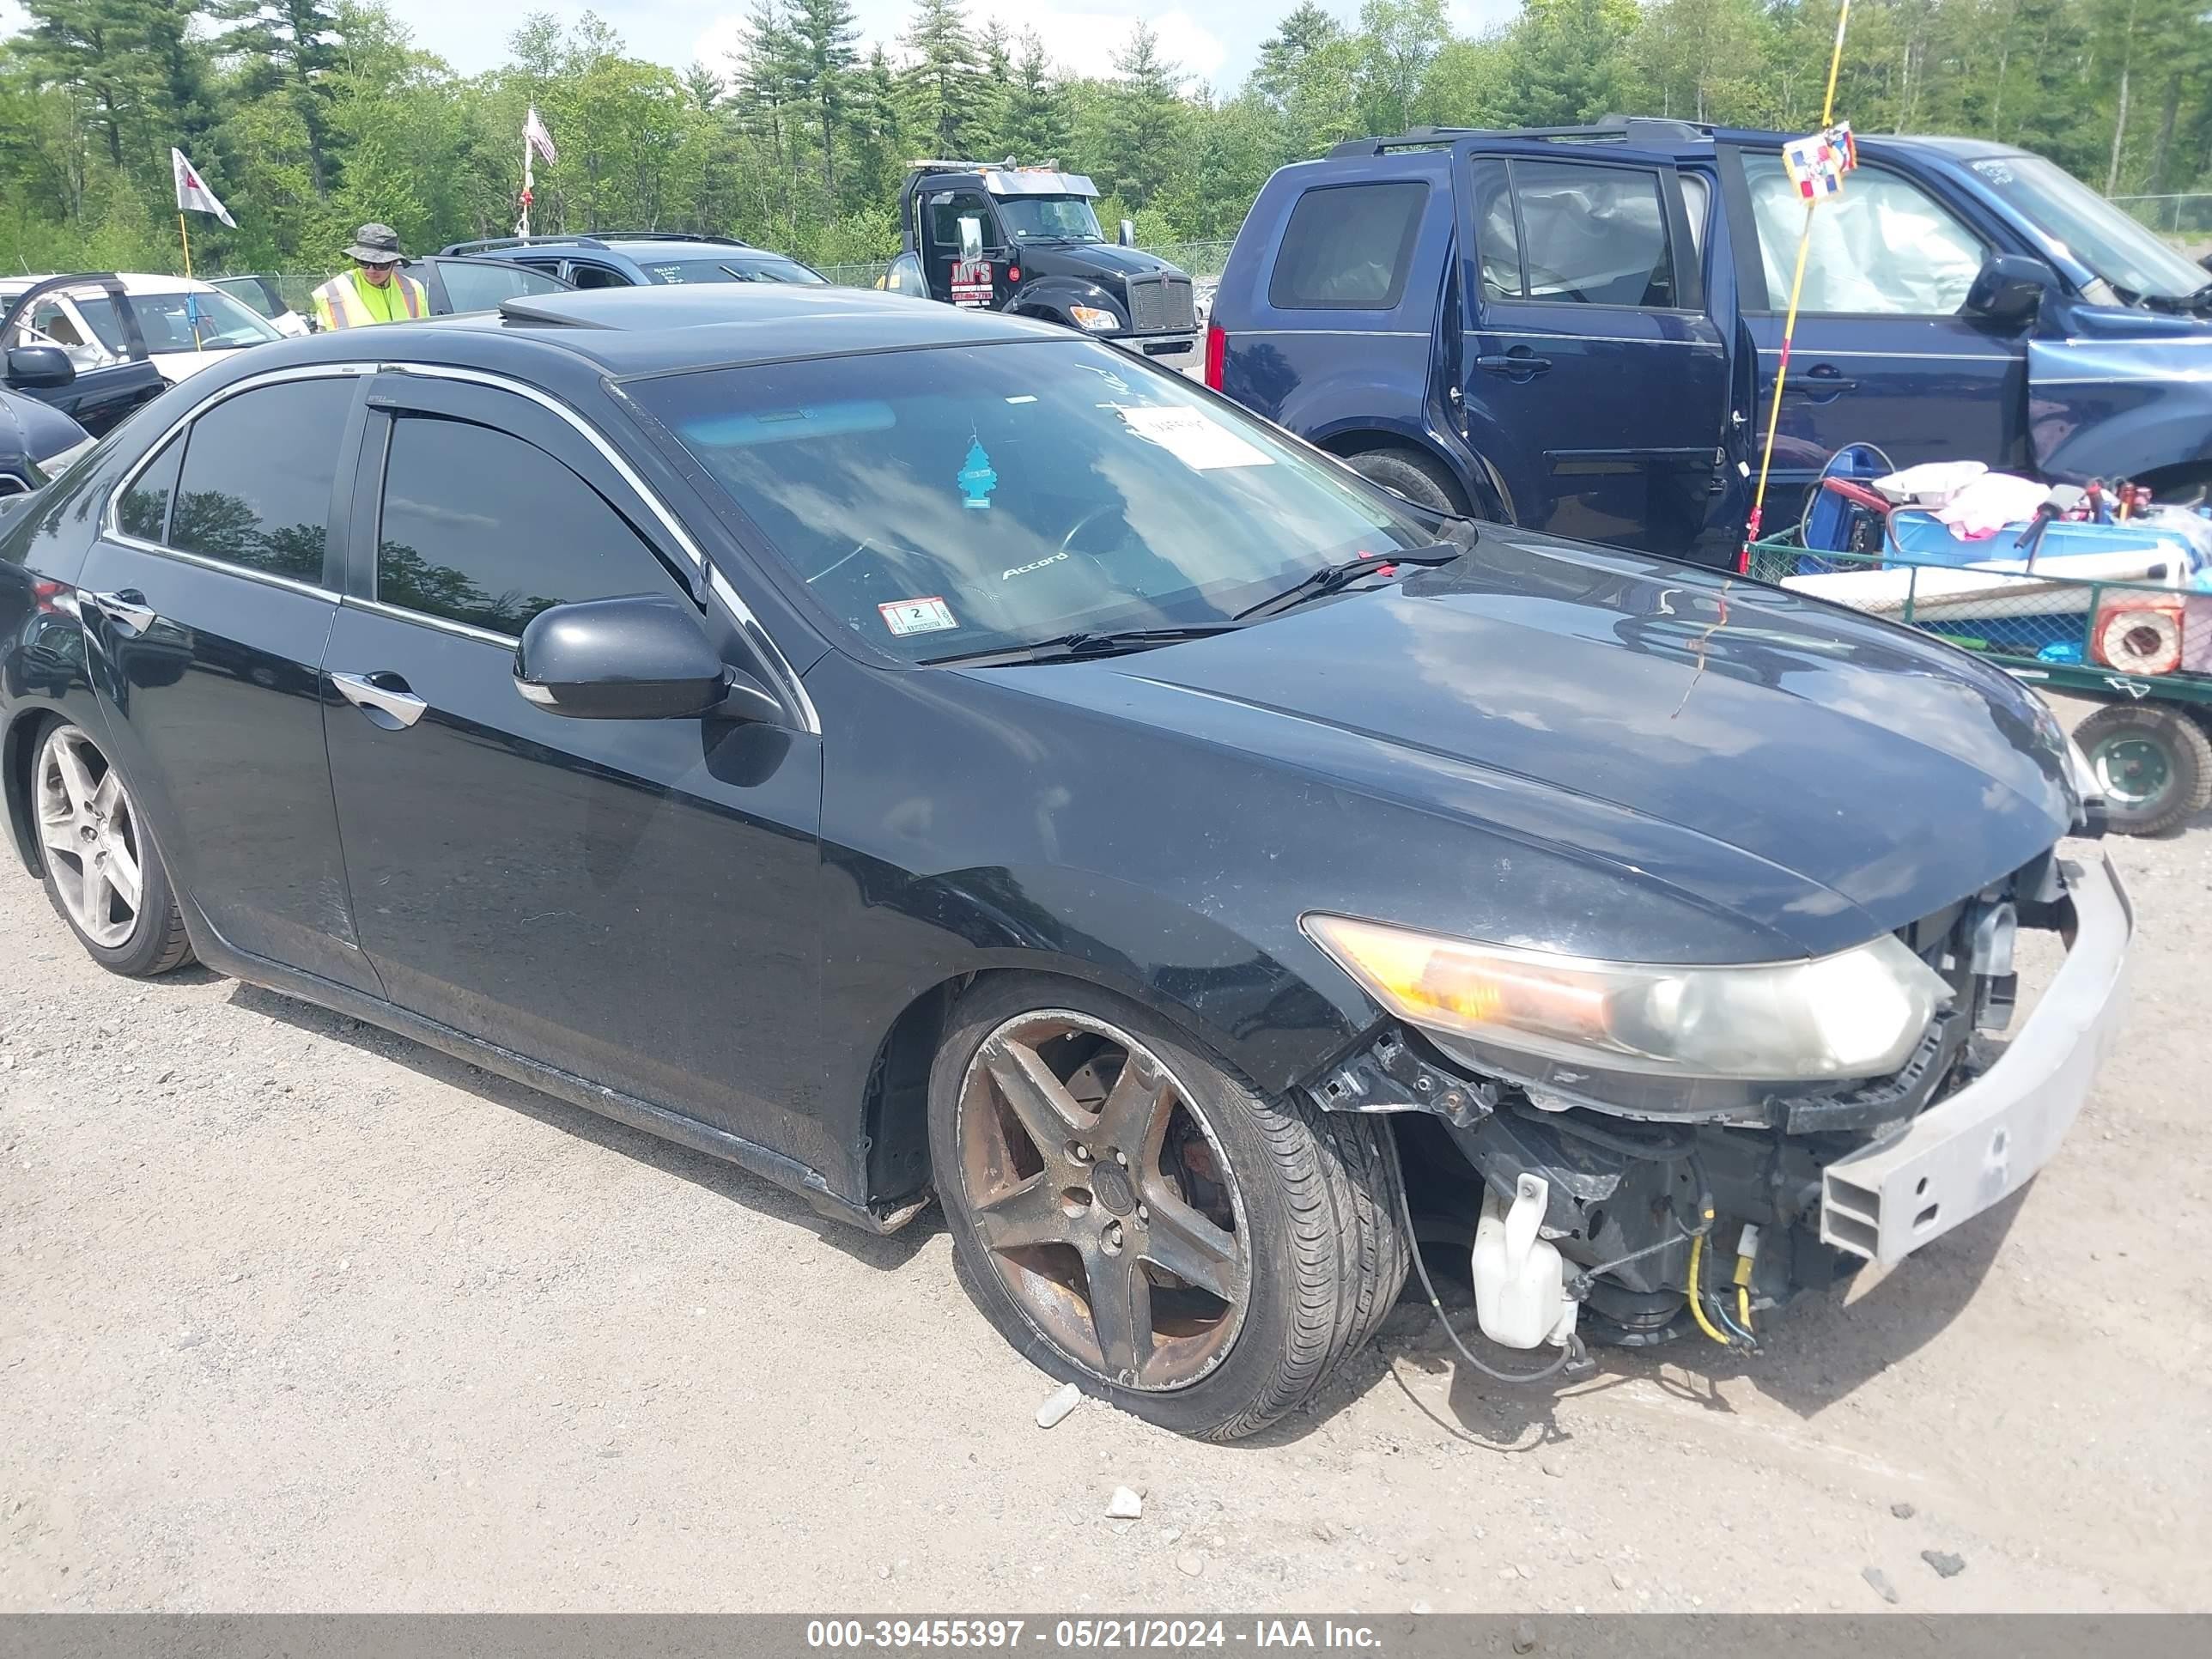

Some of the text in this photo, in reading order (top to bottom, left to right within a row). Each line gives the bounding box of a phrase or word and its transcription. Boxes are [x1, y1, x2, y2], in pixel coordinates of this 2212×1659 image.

[951, 262, 992, 285] JAY'S
[1002, 552, 1069, 580] Accord
[910, 608, 923, 618] 2
